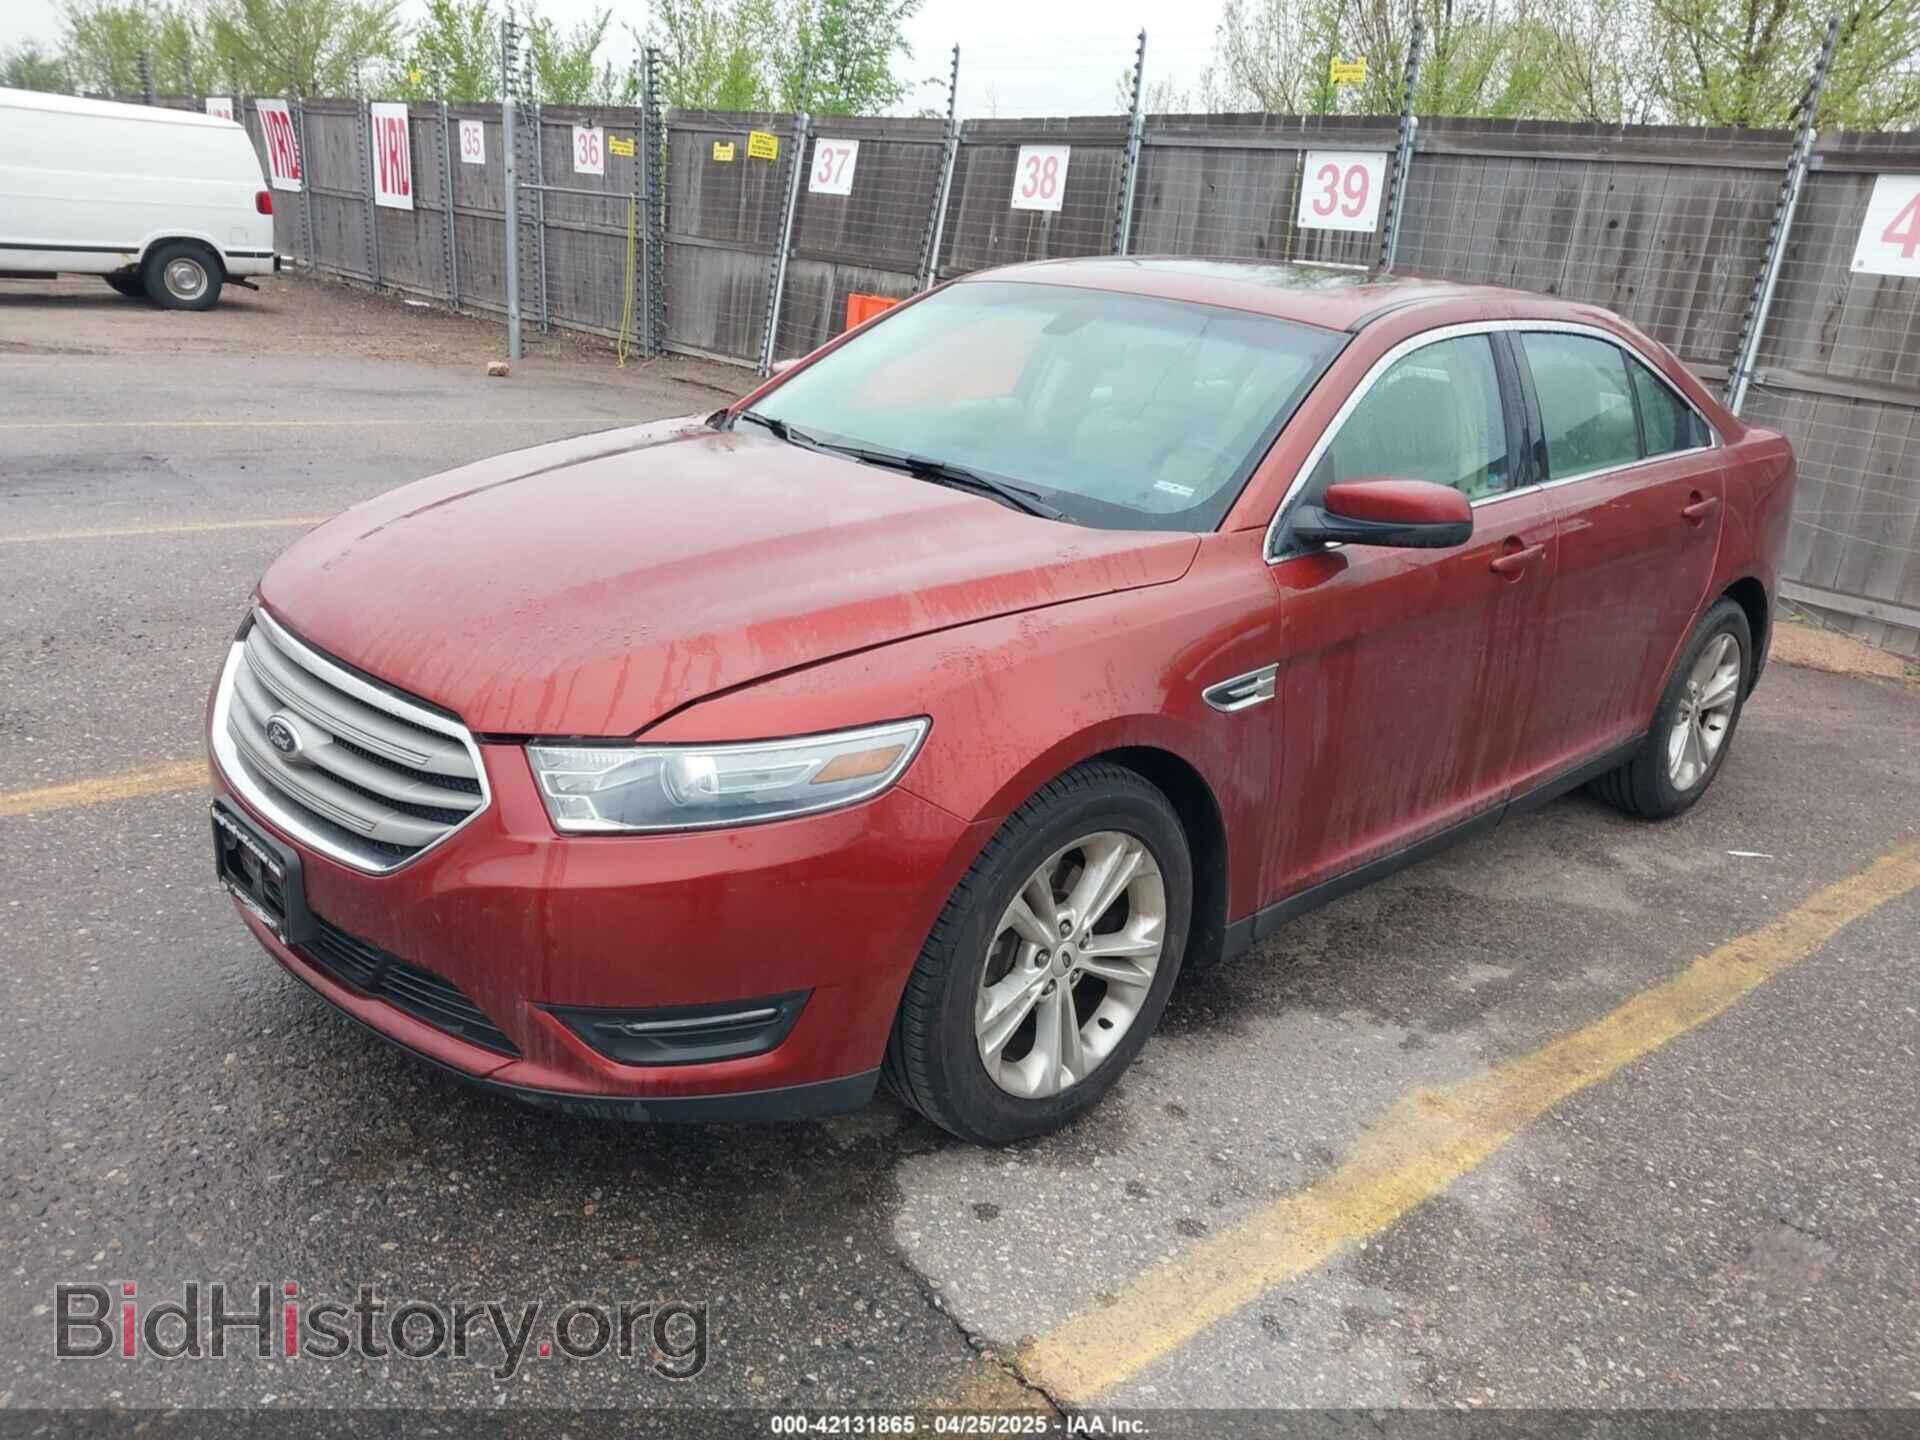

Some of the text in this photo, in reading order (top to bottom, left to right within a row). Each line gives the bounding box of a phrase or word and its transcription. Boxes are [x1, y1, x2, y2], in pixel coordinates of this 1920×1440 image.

[463, 126, 480, 156] 35
[578, 133, 599, 166] 36
[818, 147, 850, 185] 37
[1022, 155, 1058, 199] 38
[1312, 163, 1369, 218] 39
[269, 724, 291, 751] Ford
